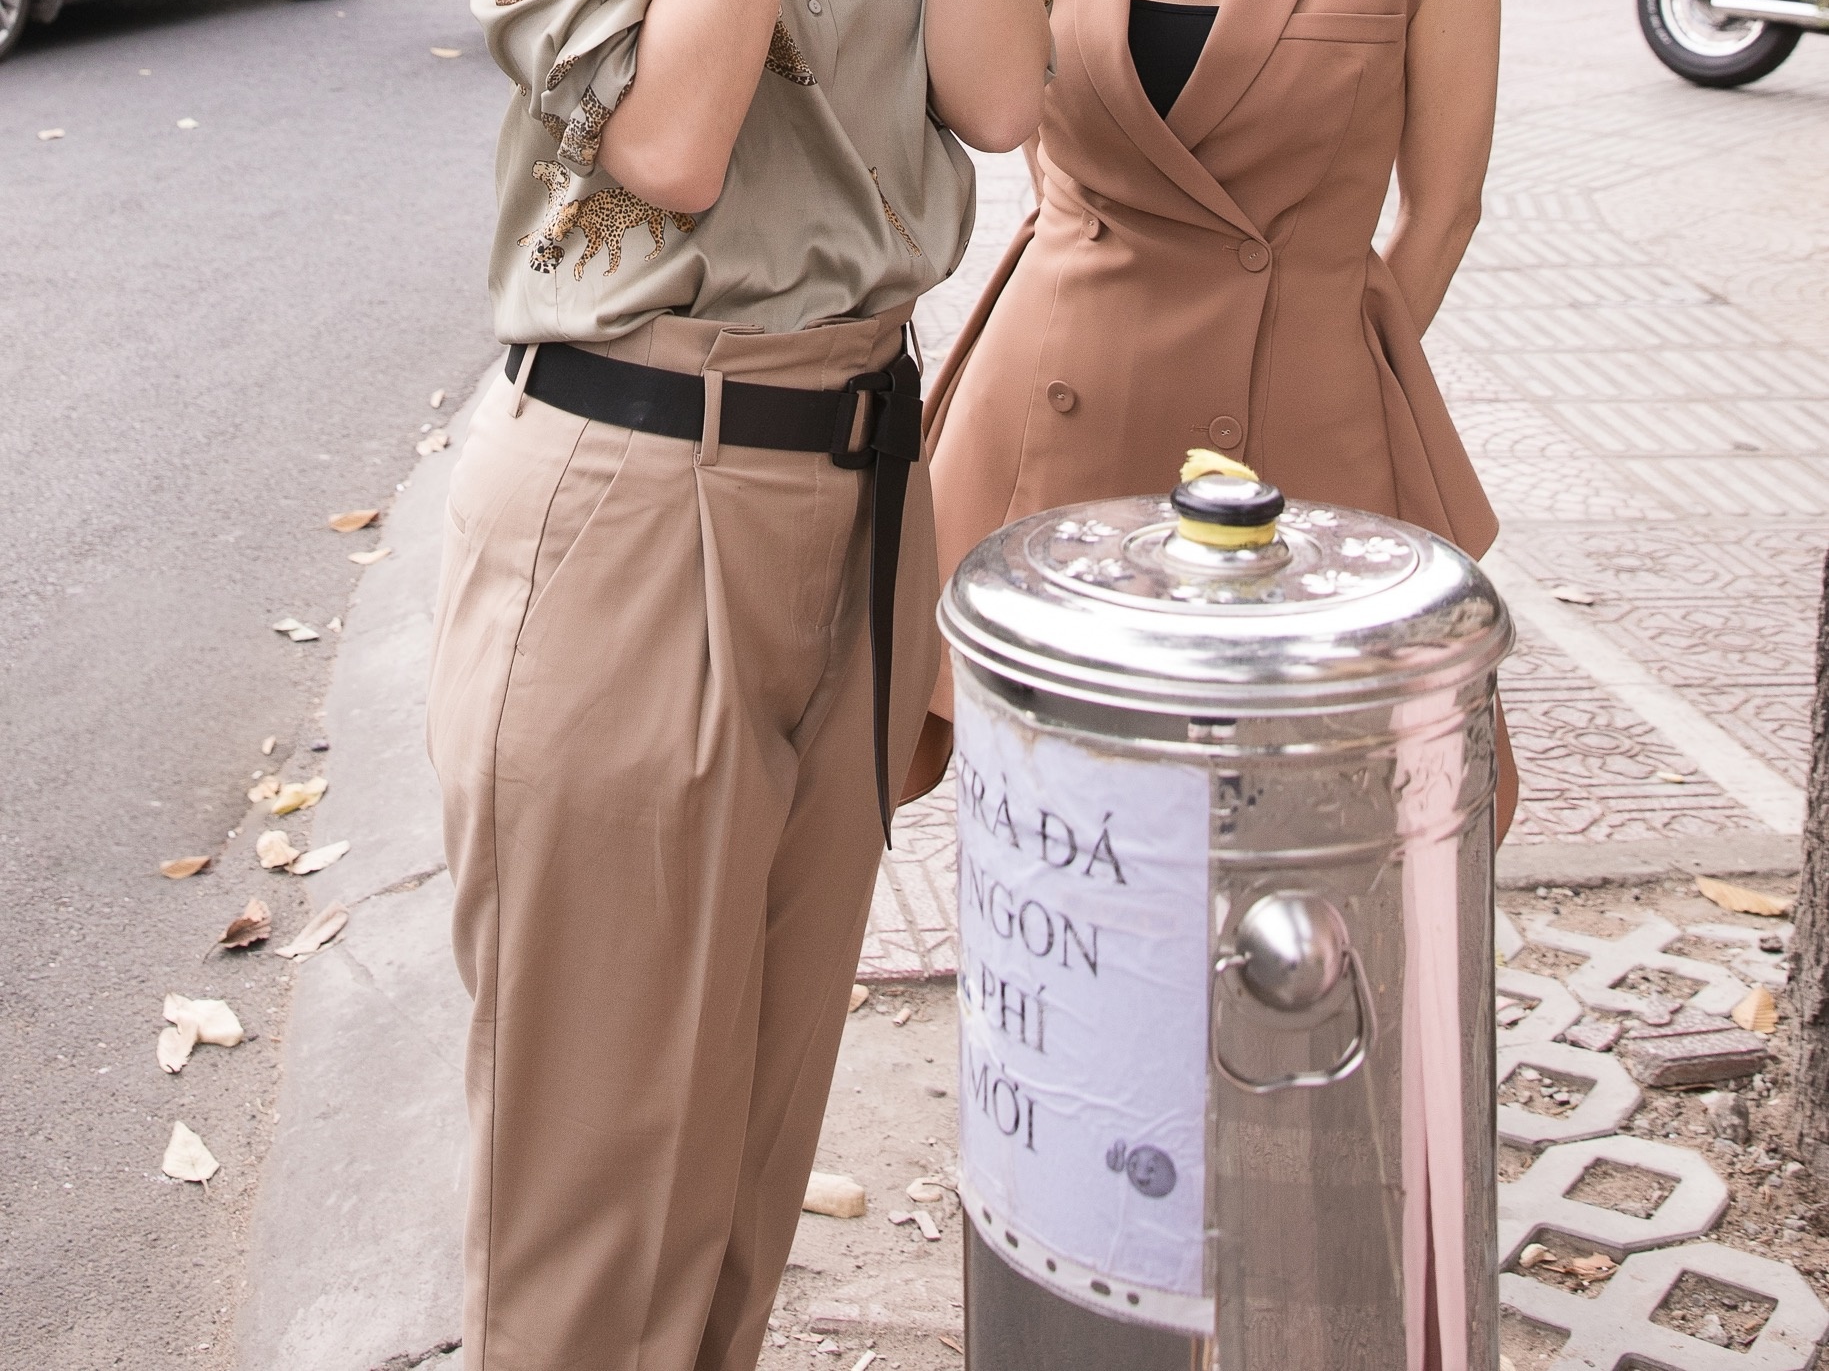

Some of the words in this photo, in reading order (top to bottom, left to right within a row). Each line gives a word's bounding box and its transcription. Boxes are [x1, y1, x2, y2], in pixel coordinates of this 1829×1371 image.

[960, 750, 1021, 851] TRÀ
[1036, 809, 1126, 886] ĐÁ
[968, 853, 1099, 977] NGON
[981, 961, 1048, 1055] PHÍ
[968, 1043, 1036, 1152] MỜI
